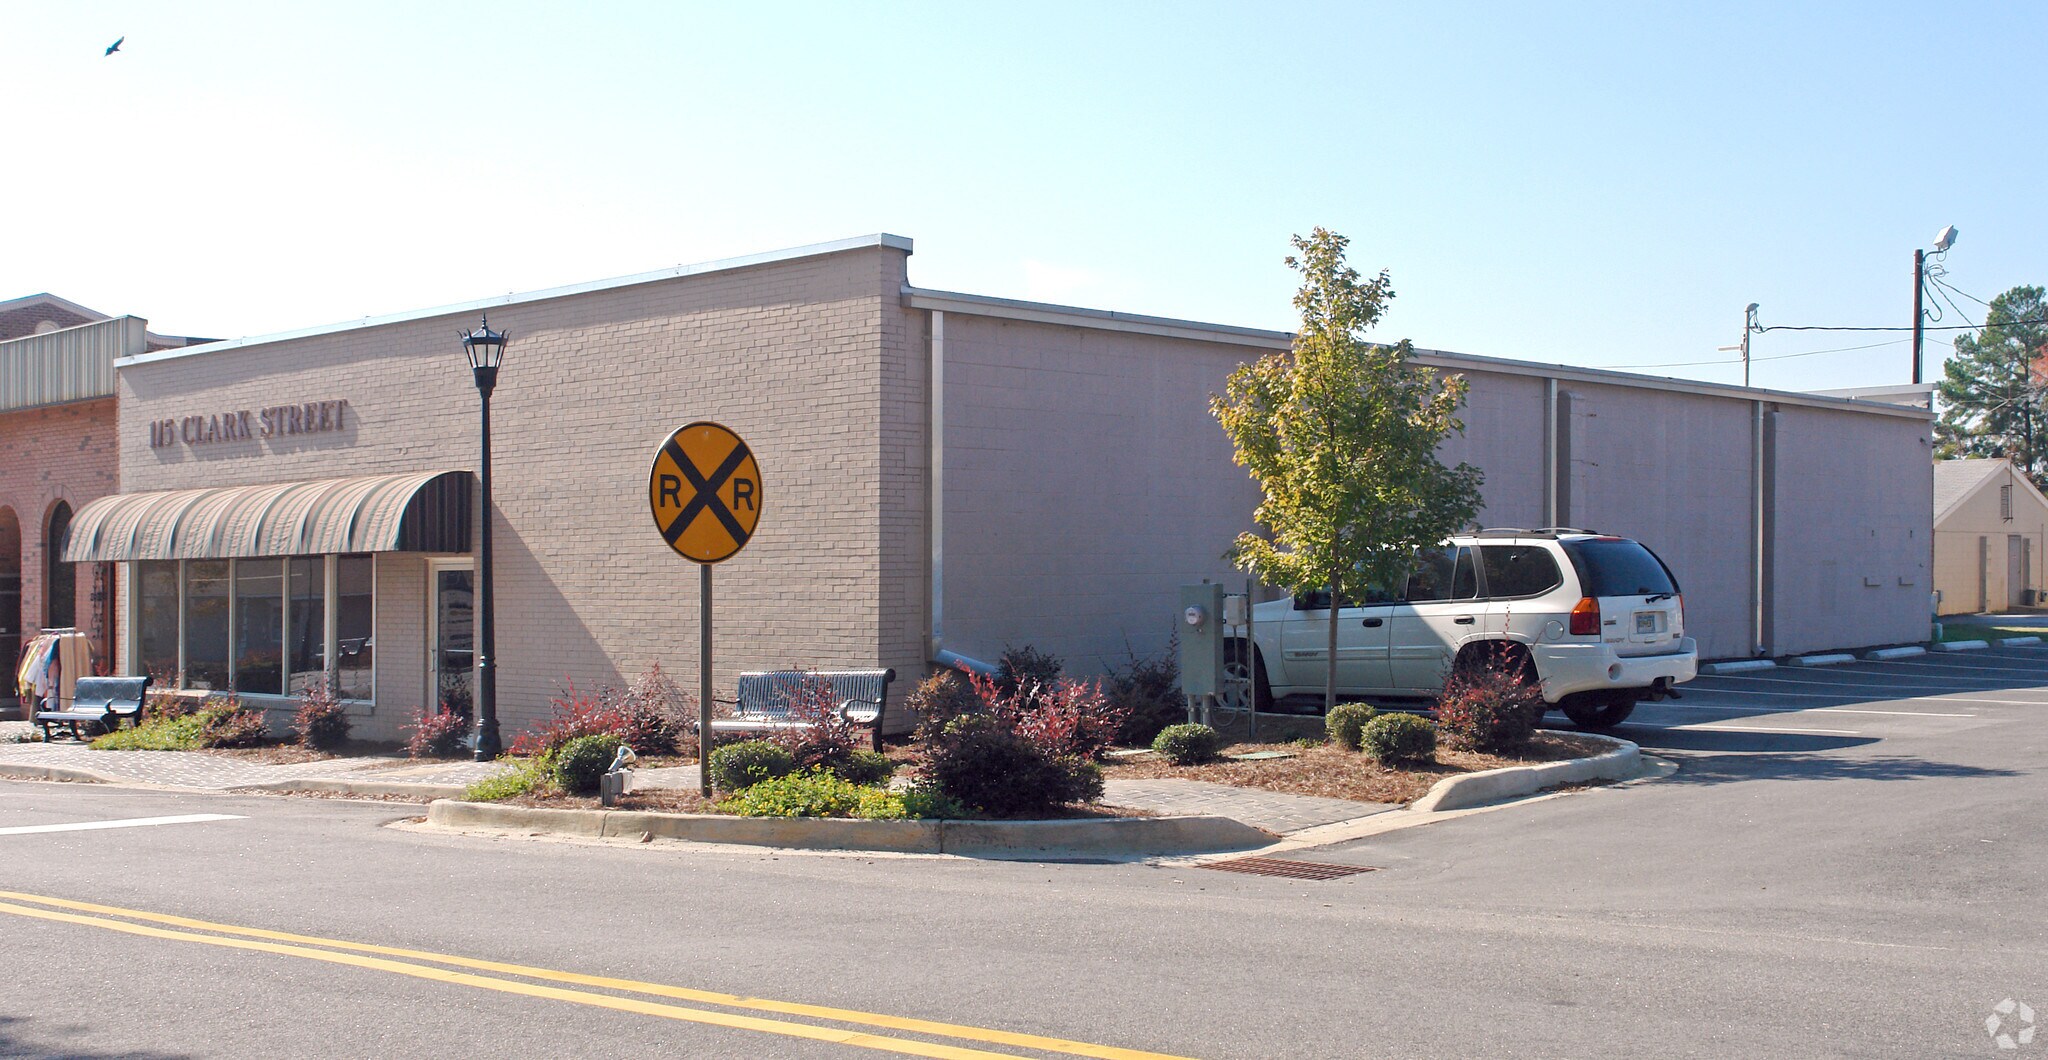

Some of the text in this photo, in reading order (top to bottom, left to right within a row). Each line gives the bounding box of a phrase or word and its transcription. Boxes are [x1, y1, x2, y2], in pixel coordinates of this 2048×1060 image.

[150, 399, 348, 448] 115 CLARK STREET
[660, 474, 755, 511] R R
